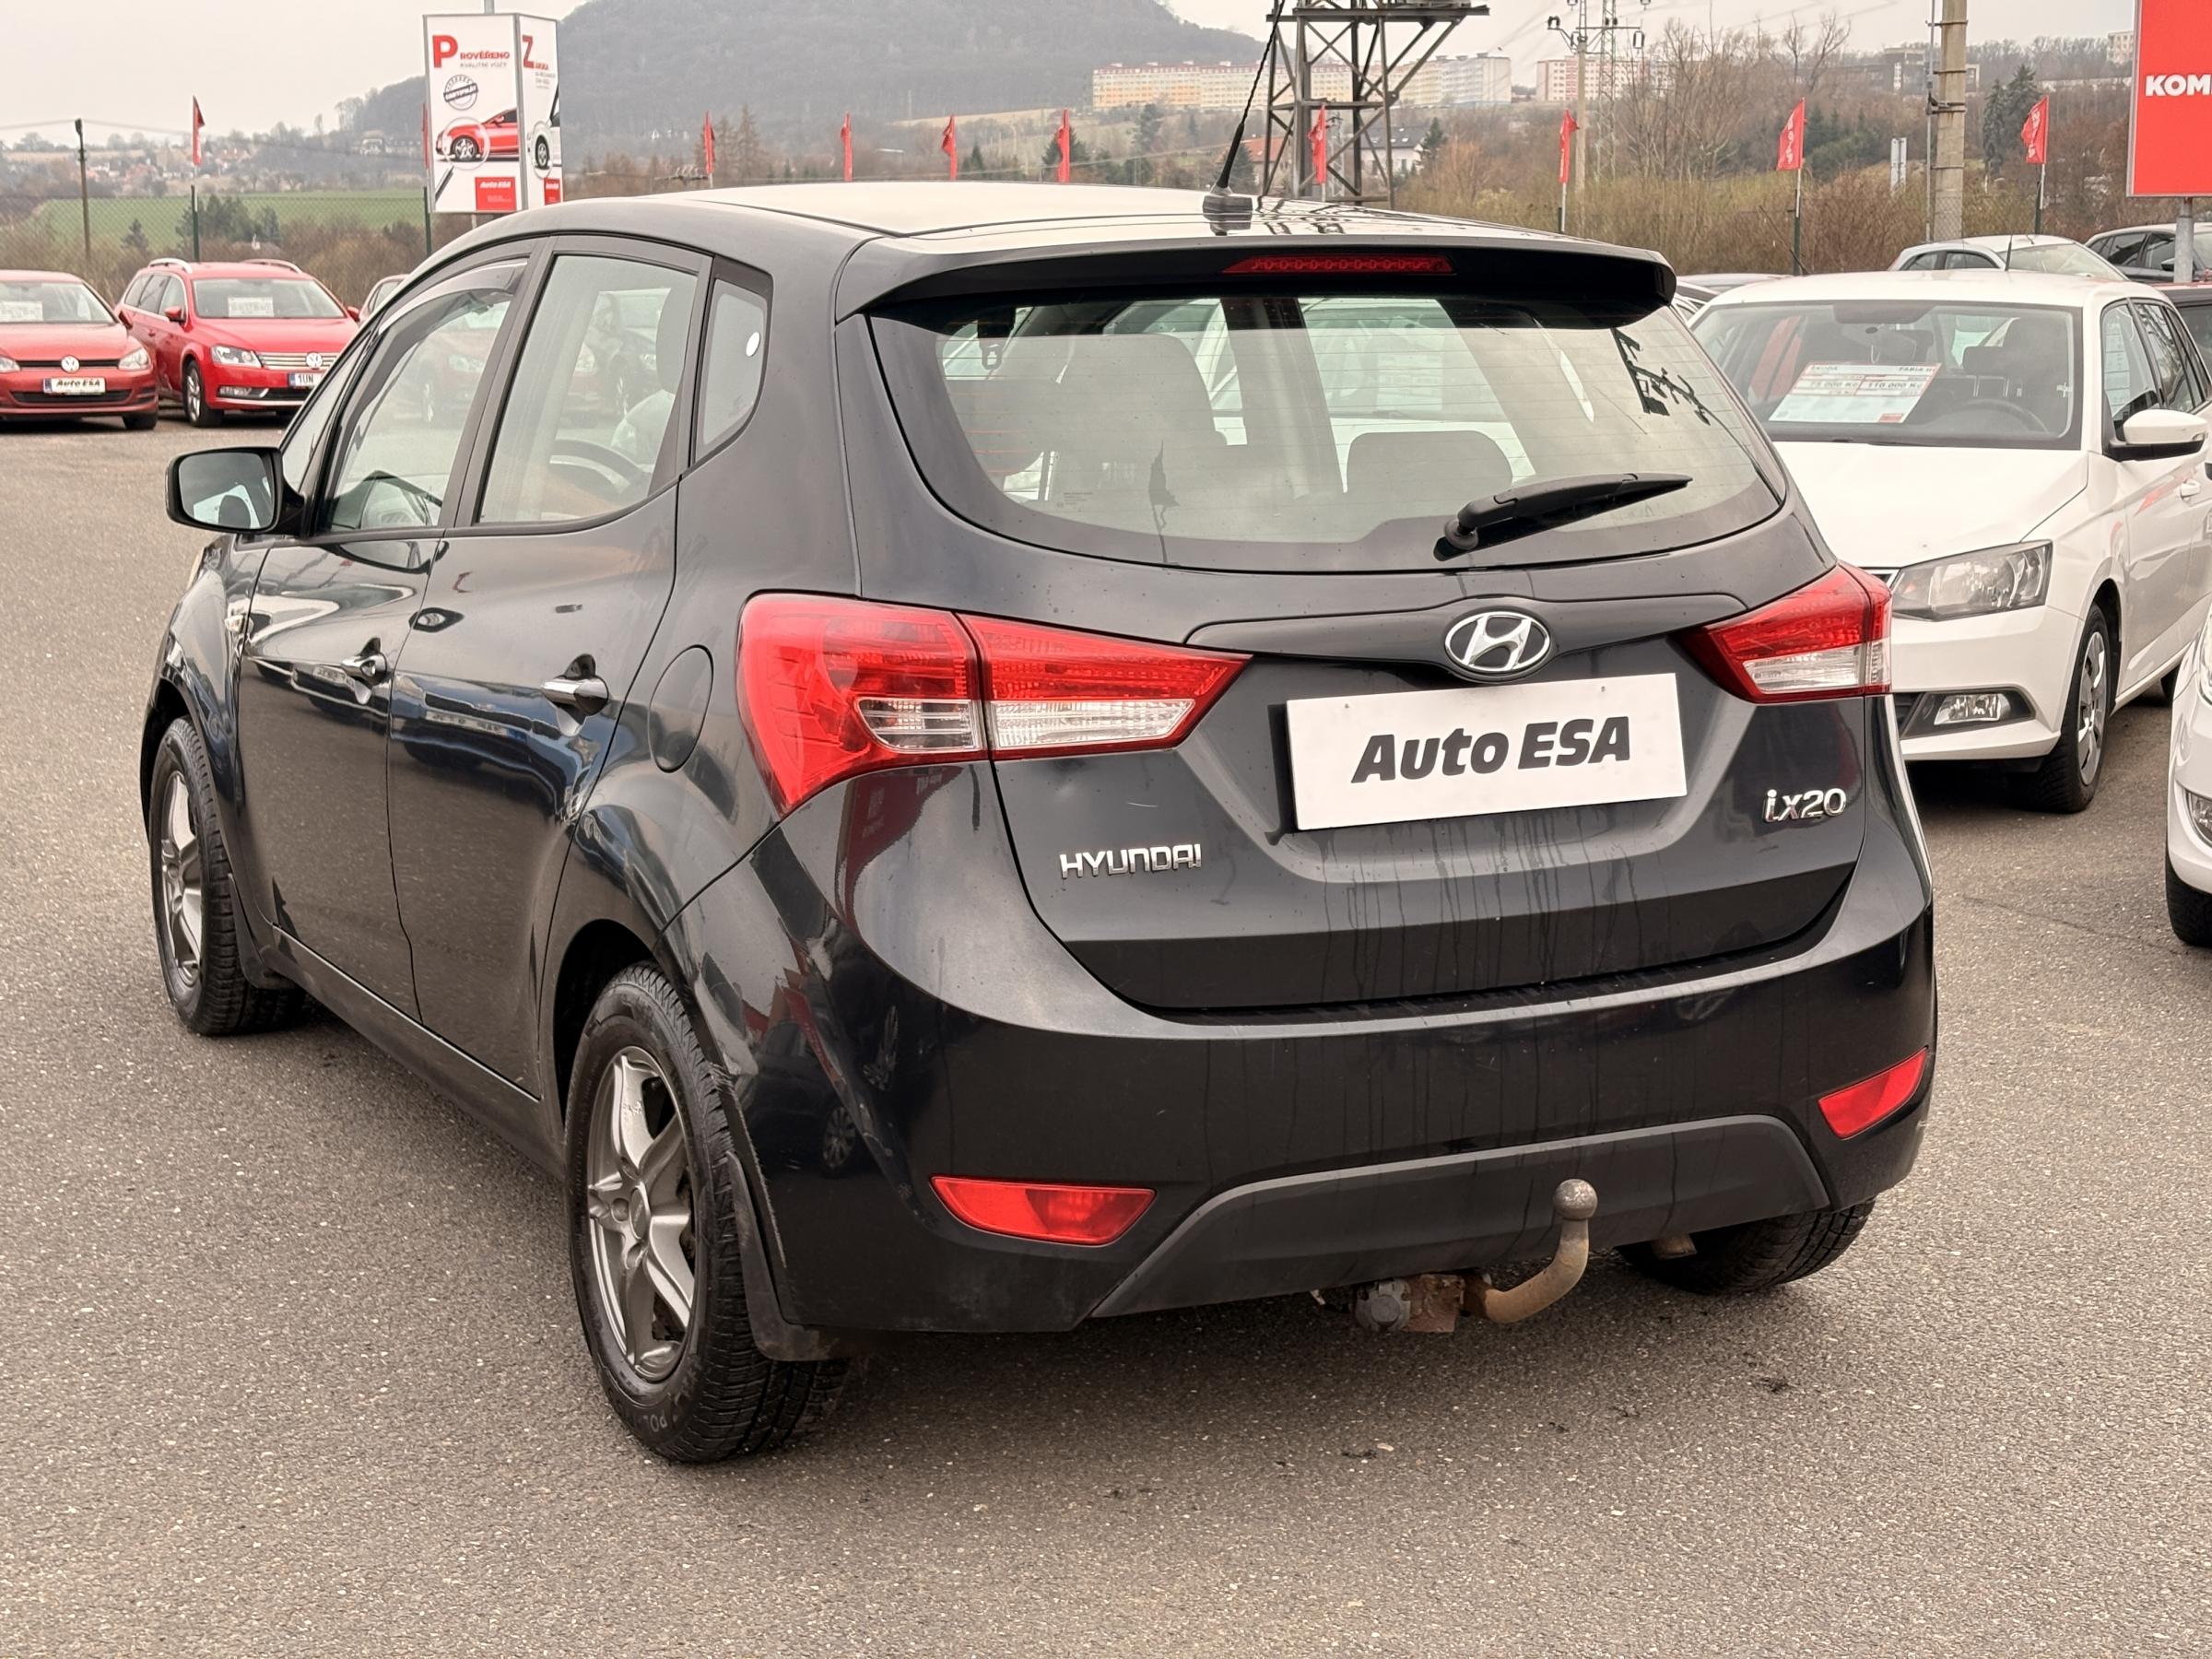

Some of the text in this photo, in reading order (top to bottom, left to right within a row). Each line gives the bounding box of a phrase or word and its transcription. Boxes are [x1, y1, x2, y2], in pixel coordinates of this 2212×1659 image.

[2146, 74, 2212, 97] KOM
[56, 379, 80, 387] Auto
[1351, 716, 1630, 783] Auto ESA
[1764, 788, 1847, 823] ix20
[1059, 843, 1202, 879] HYUNDAI
